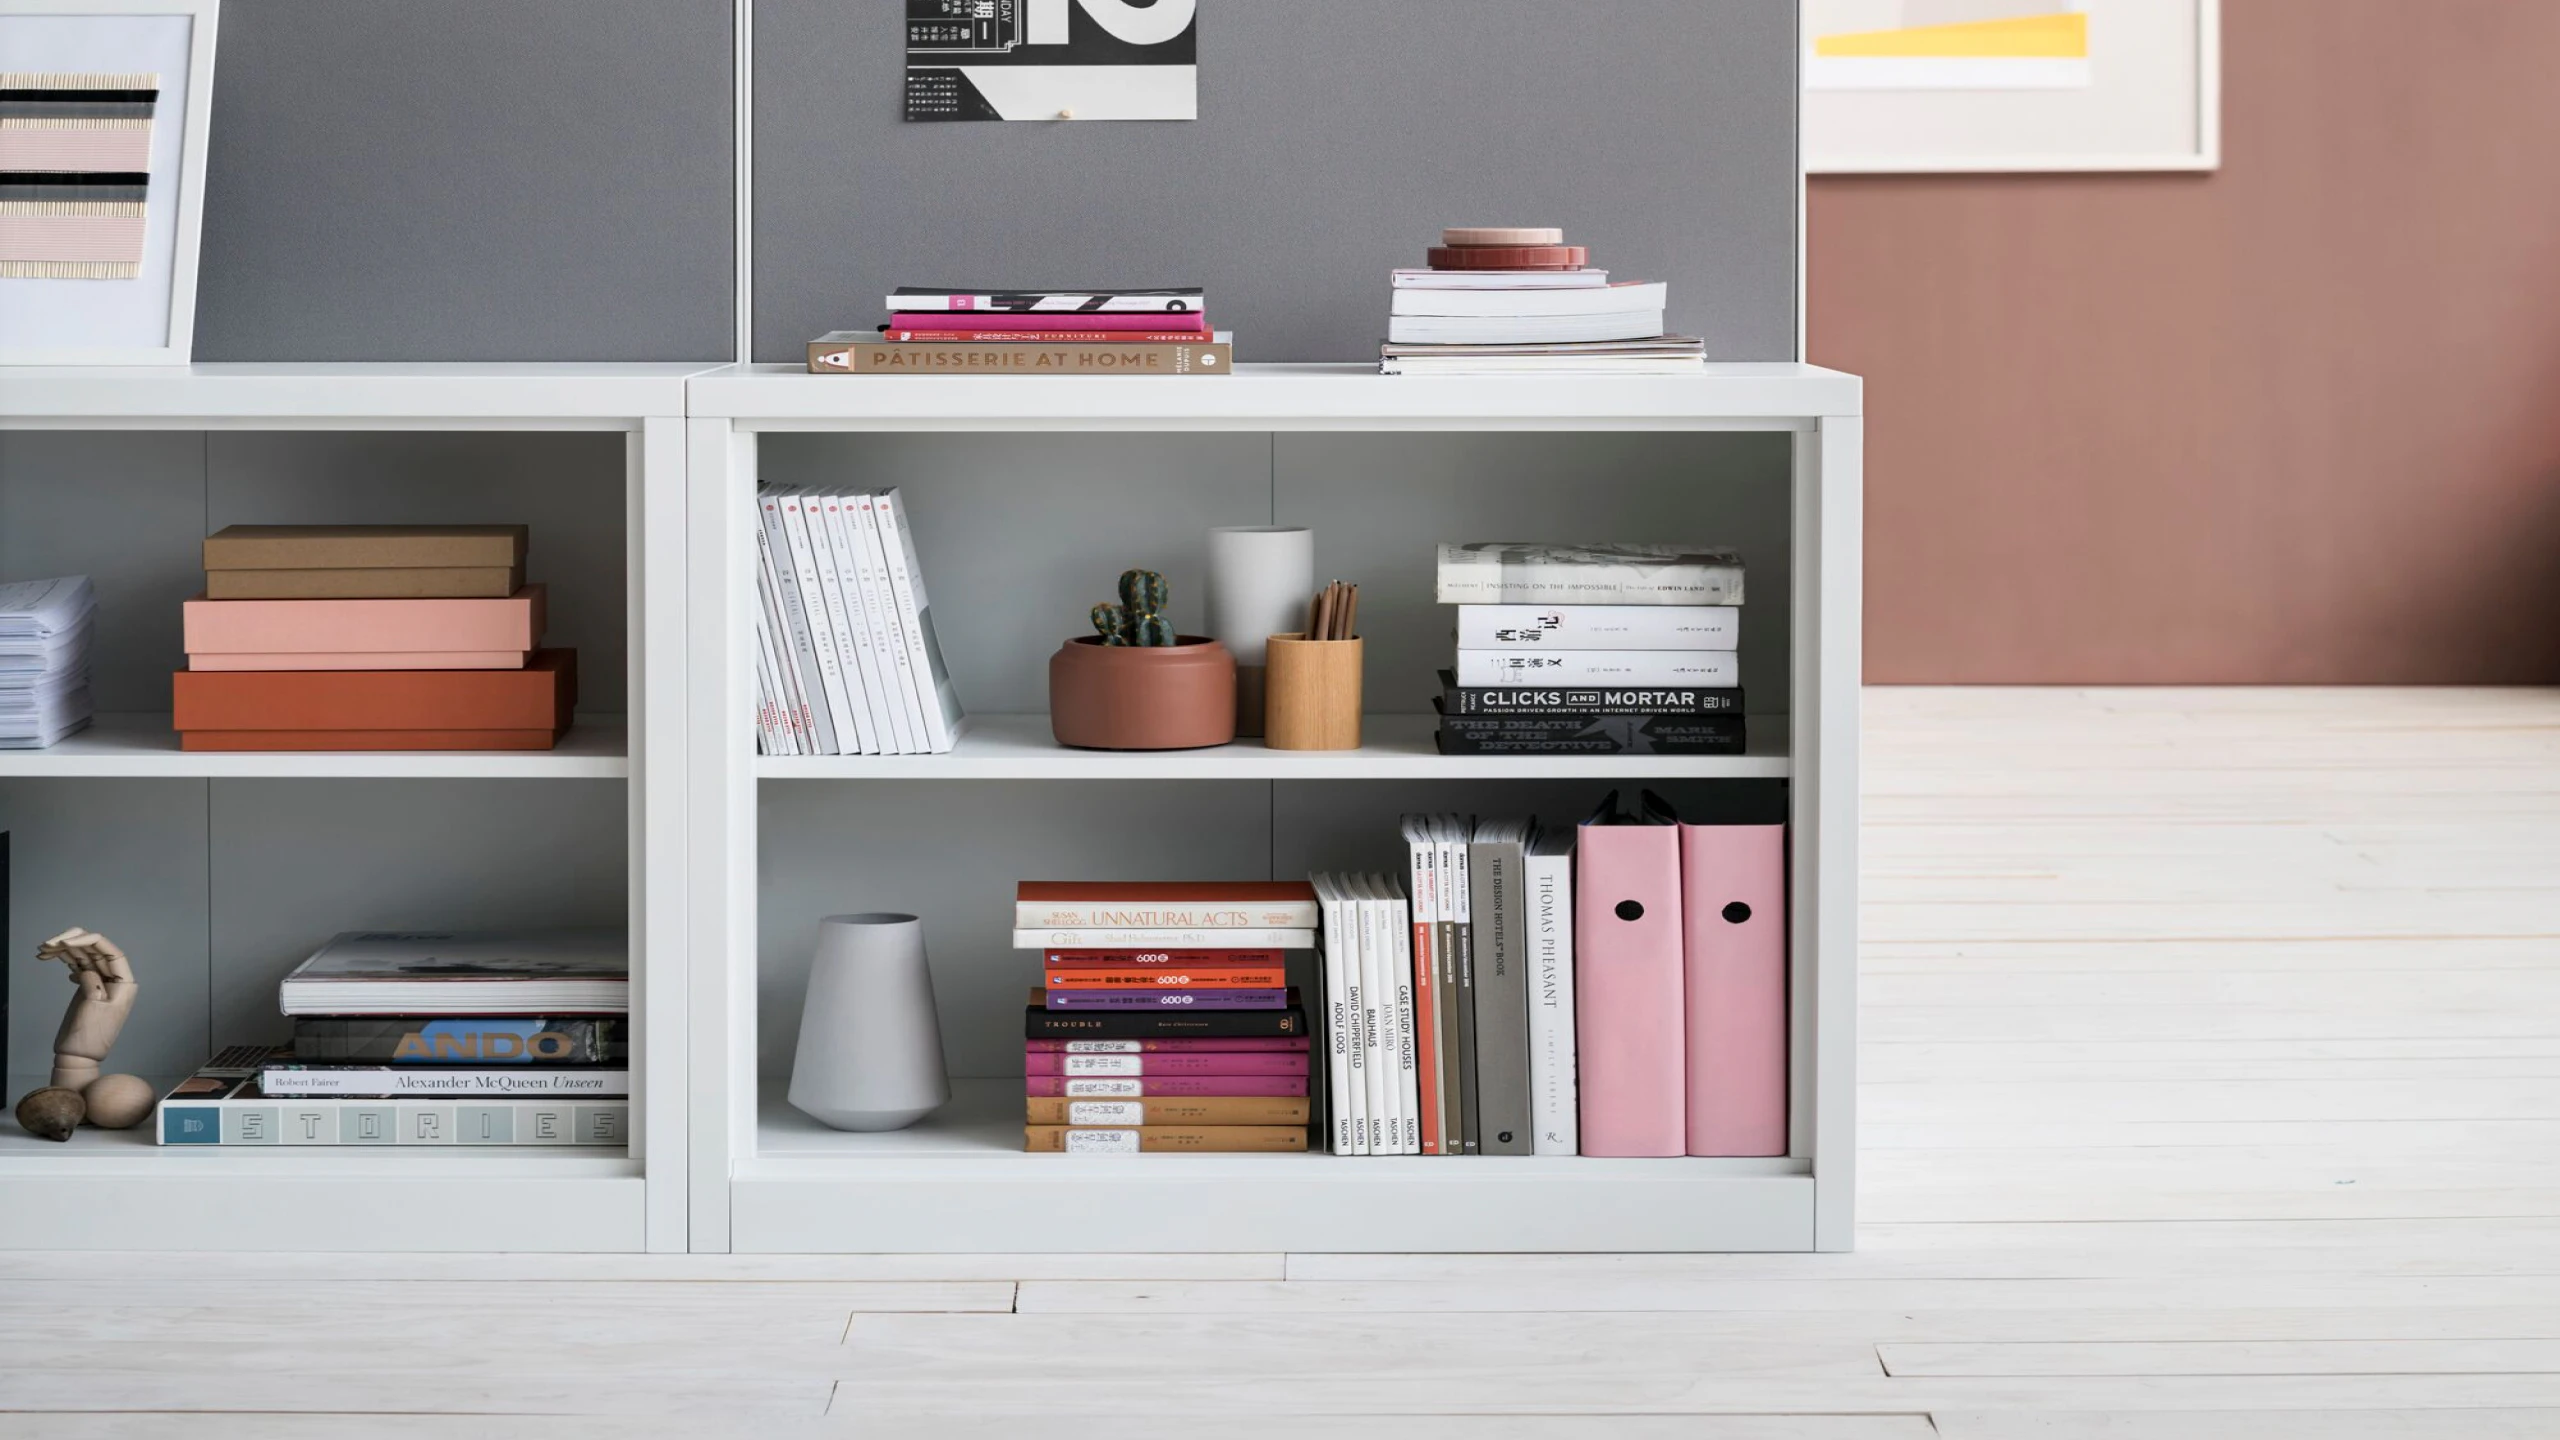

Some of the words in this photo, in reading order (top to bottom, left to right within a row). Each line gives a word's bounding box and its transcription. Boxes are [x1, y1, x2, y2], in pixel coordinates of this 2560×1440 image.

[873, 348, 1026, 366] PÂTISSERIE
[1035, 352, 1068, 366] AT
[1079, 352, 1158, 366] HOME
[1496, 616, 1558, 642] 西游记
[1491, 658, 1562, 668] 三国演义
[1483, 692, 1561, 706] CLICKS
[1605, 692, 1695, 705] MORTAR
[1450, 720, 1499, 730] THE
[1504, 720, 1582, 730] DEATH
[1466, 732, 1494, 740] OF
[1500, 732, 1548, 740] THE
[1654, 726, 1716, 734] MARK
[1480, 742, 1612, 750] DETECTIVE
[1492, 858, 1502, 876] THE
[1493, 878, 1503, 911] DESIGN
[1540, 874, 1554, 933] THOMAS
[1092, 911, 1199, 926] UNNATURAL
[1202, 911, 1248, 926] ACTS
[1496, 952, 1505, 976] BOOK
[1542, 939, 1557, 1009] PHEASANT
[1350, 986, 1360, 1011] DAVID
[1399, 985, 1409, 1006] CASE
[1334, 1002, 1344, 1029] ADOLF
[1383, 1004, 1394, 1025] JOAN
[1400, 1007, 1410, 1035] STUDY
[1350, 1013, 1362, 1068] CHIPPERFIELD
[1366, 1008, 1377, 1048] BAUHAUS
[392, 1032, 572, 1059] ANDO
[1336, 1031, 1346, 1054] LOOS
[1401, 1036, 1412, 1070] HOUSES
[274, 1077, 309, 1088] Robert
[312, 1077, 340, 1088] Fairer
[396, 1076, 471, 1088] Alexander
[475, 1076, 548, 1091] McQueen
[552, 1076, 604, 1088] Unseen
[242, 1114, 615, 1139] STORIES
[1356, 1118, 1364, 1146] TASCHEN
[1373, 1118, 1381, 1146] TASCHEN
[1390, 1117, 1398, 1146] TASCHEN
[1406, 1118, 1415, 1146] TASCHEN
